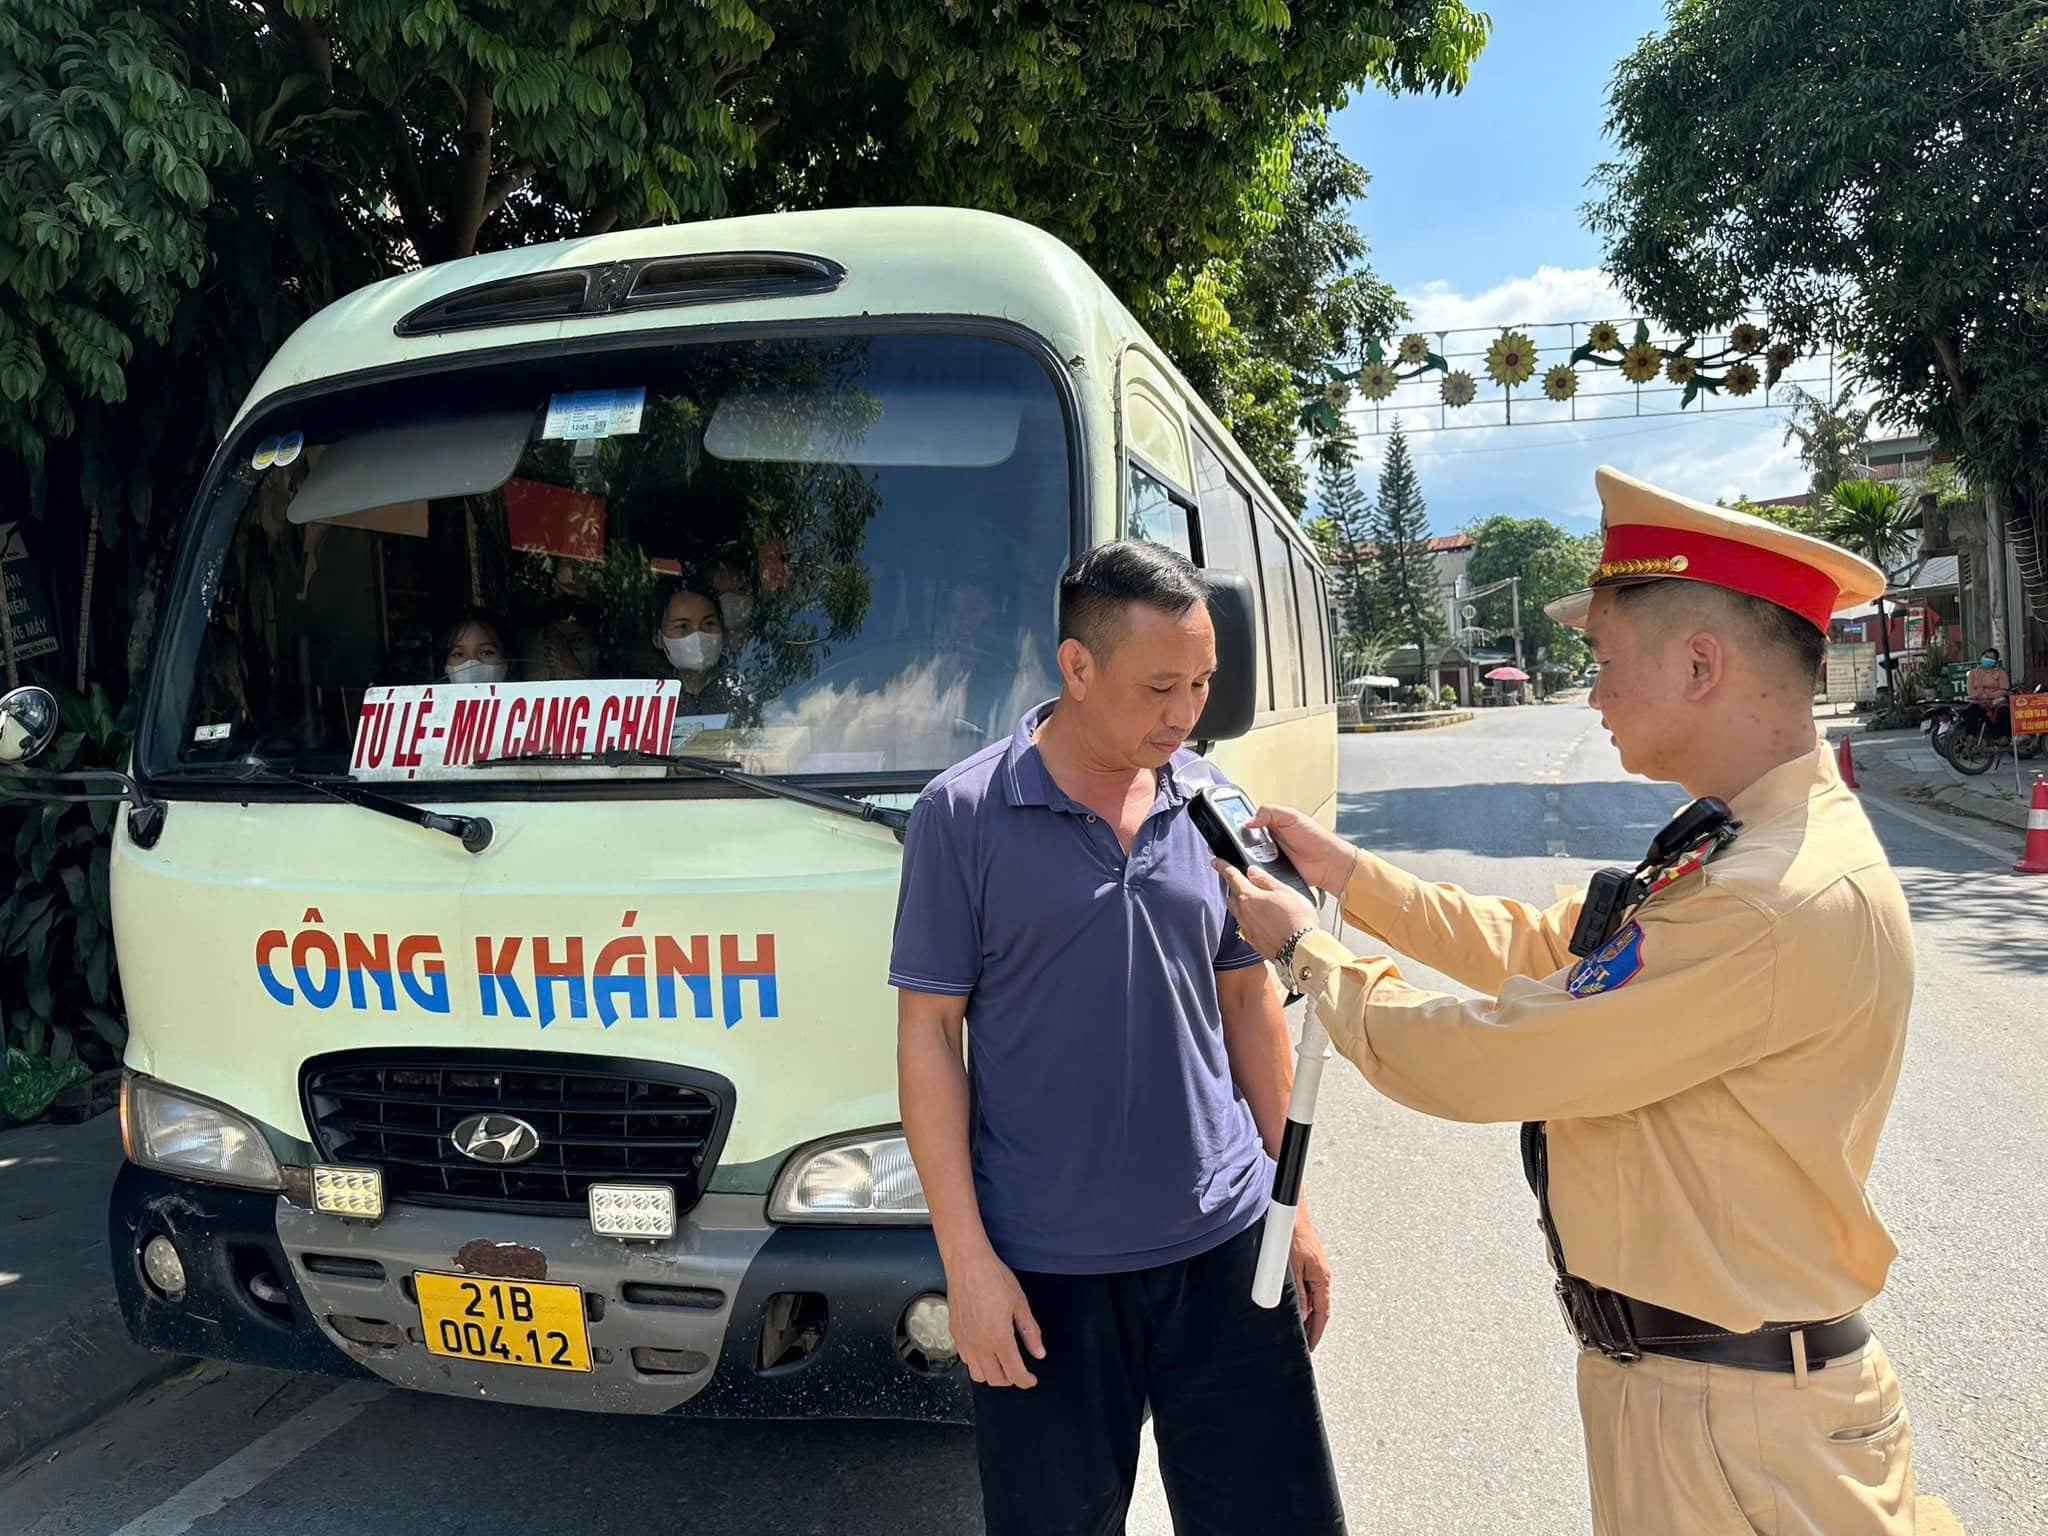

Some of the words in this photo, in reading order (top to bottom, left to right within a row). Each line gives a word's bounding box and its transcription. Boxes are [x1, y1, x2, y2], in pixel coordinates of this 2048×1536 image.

[354, 688, 395, 769] TÚ
[391, 687, 434, 779] LỆ
[442, 685, 502, 766] MÙ
[501, 695, 591, 759] CANG
[594, 679, 678, 758] CHẢI
[255, 907, 451, 1014] CÔNG
[474, 910, 779, 1030] KHÁNH
[460, 1282, 534, 1322] 21B
[439, 1319, 573, 1367] 004.12
